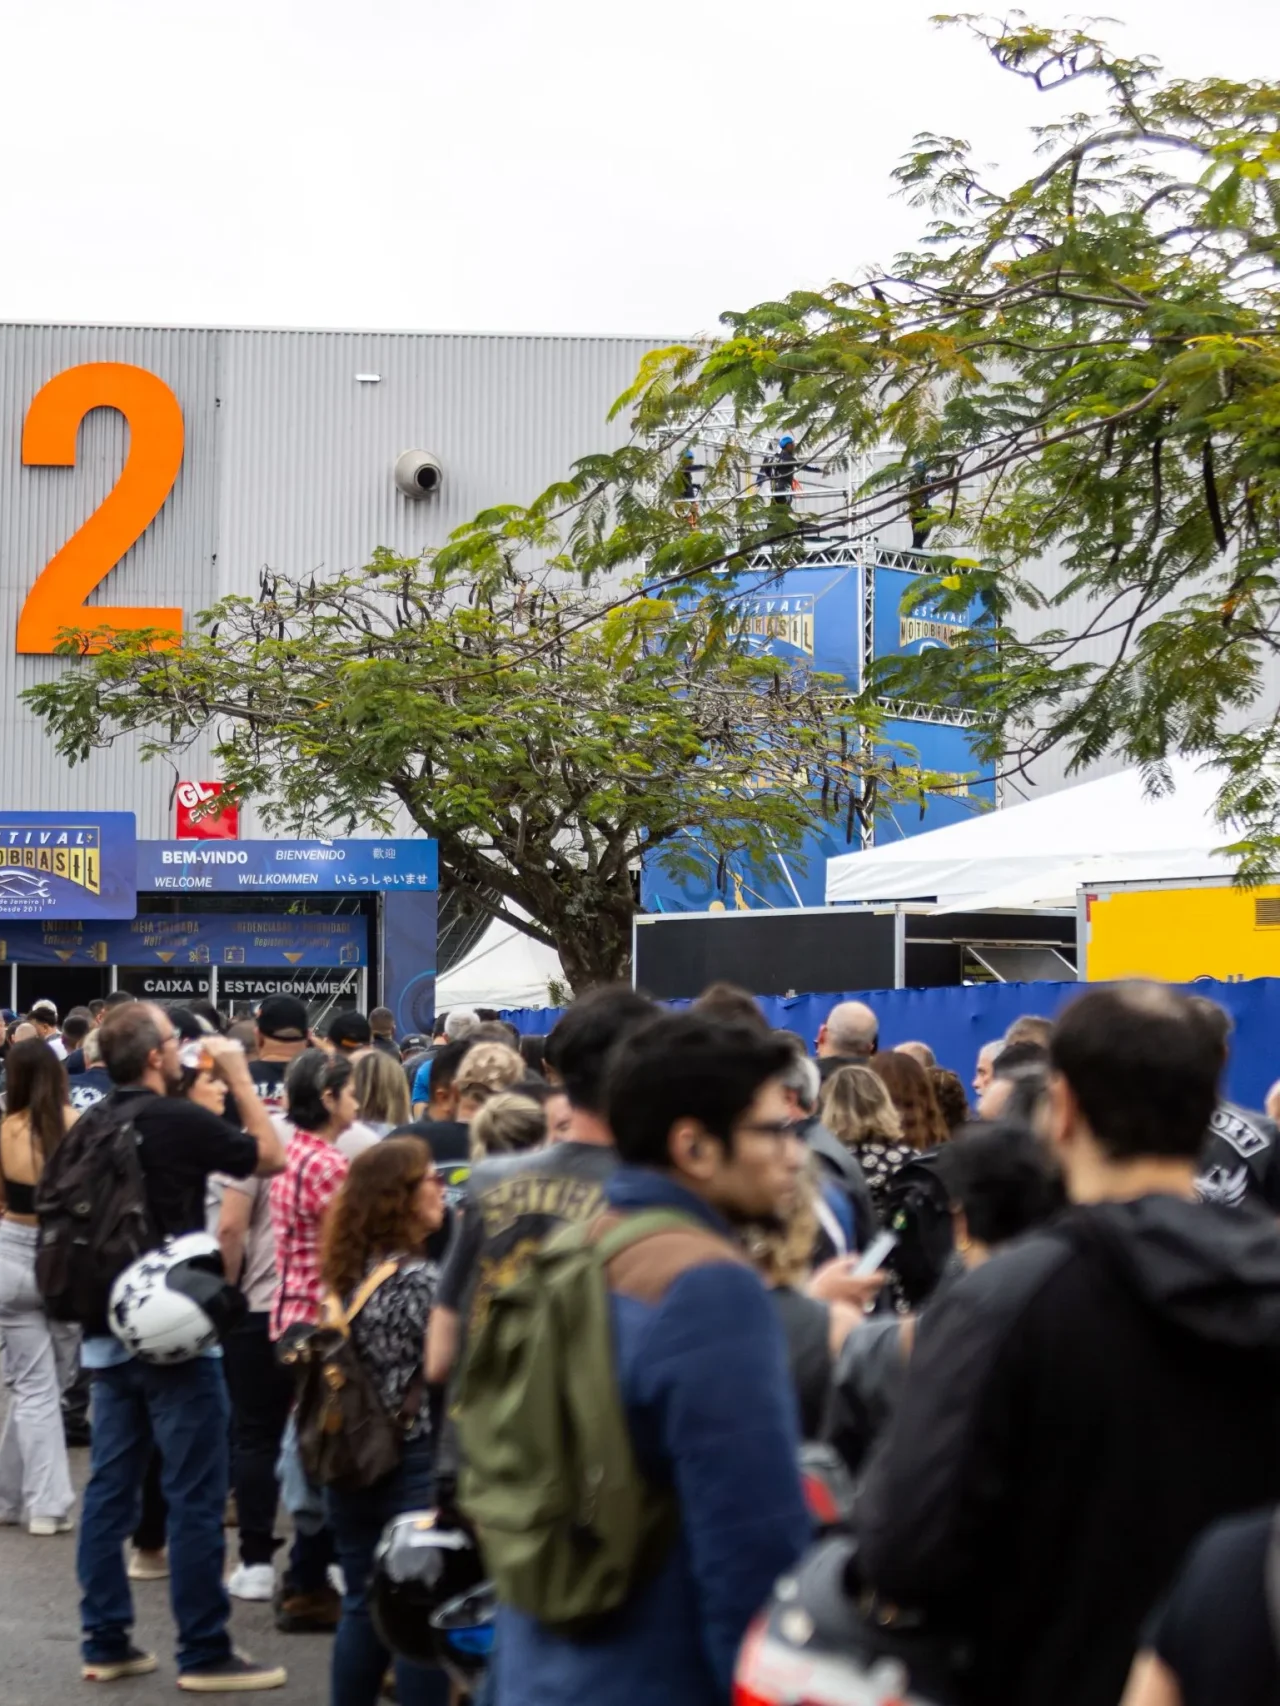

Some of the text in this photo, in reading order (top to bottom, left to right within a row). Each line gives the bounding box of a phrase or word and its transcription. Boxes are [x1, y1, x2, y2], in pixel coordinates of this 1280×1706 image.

[16, 361, 185, 655] 2
[730, 616, 813, 651] OBRASIL
[178, 780, 215, 808] GL
[162, 851, 248, 865] BEM-VINDO
[275, 850, 346, 861] BIENVENIDO
[154, 877, 213, 888] WELCOME
[238, 873, 319, 885] WILLKOMMEN
[334, 873, 428, 885] いらっしゃいませ
[144, 979, 358, 995] CAIXA D ESTACIONAMENT
